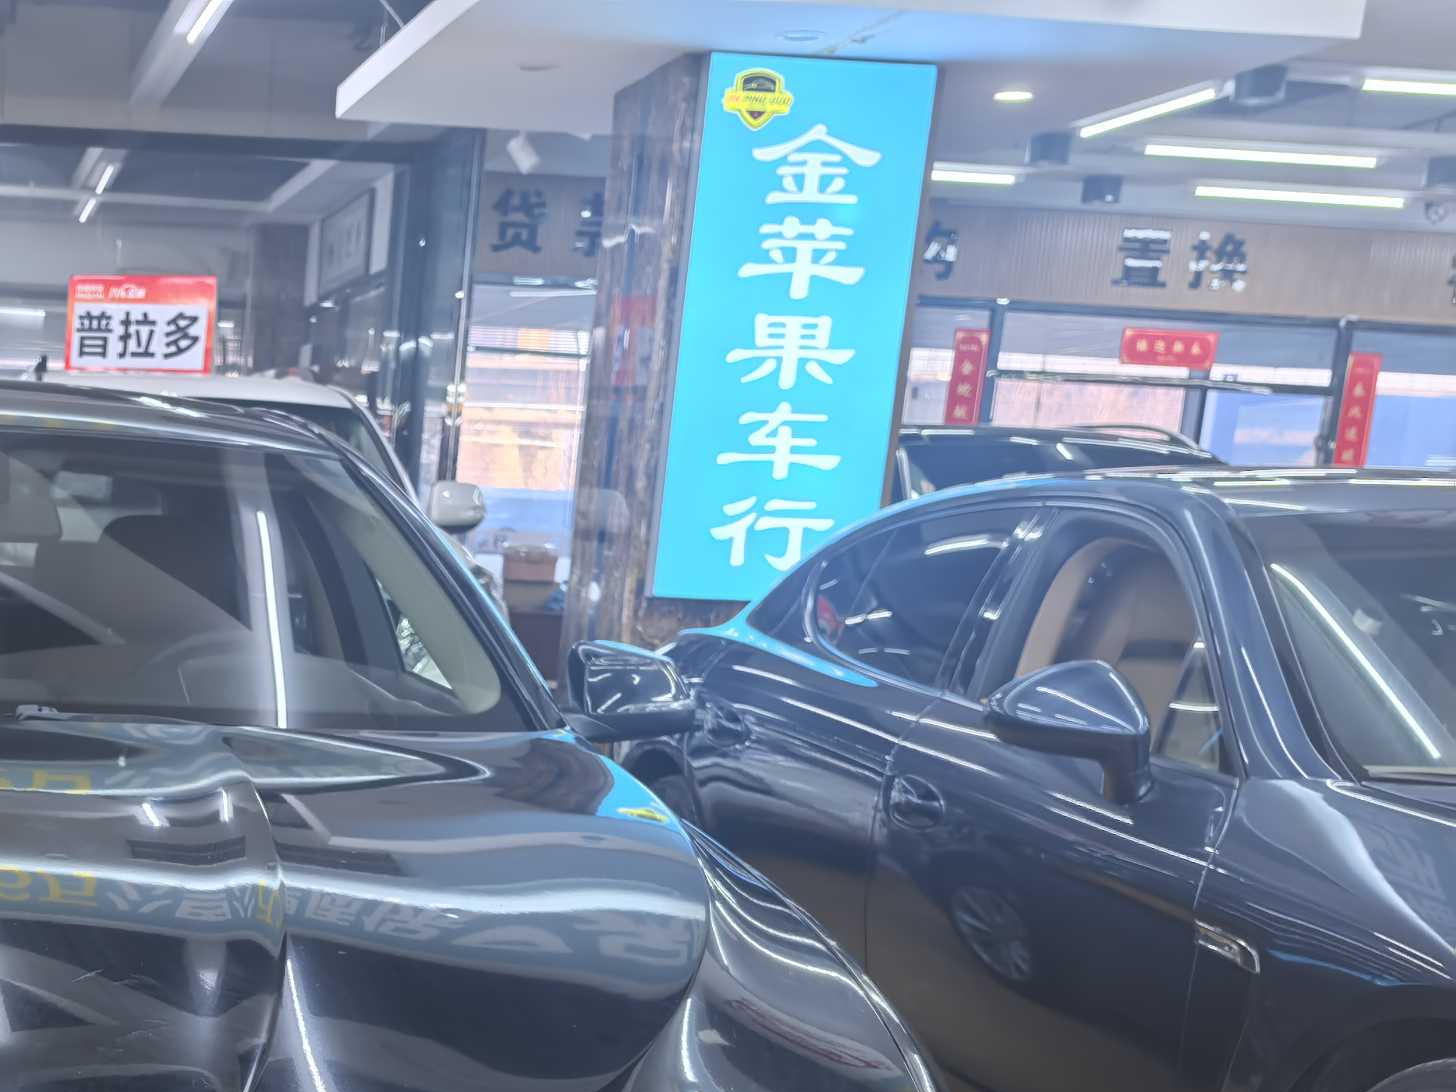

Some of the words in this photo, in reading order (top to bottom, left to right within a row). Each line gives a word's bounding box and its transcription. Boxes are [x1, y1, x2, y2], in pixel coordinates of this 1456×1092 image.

[76, 310, 200, 360] 普拉多
[710, 124, 881, 570] 金苹果车行
